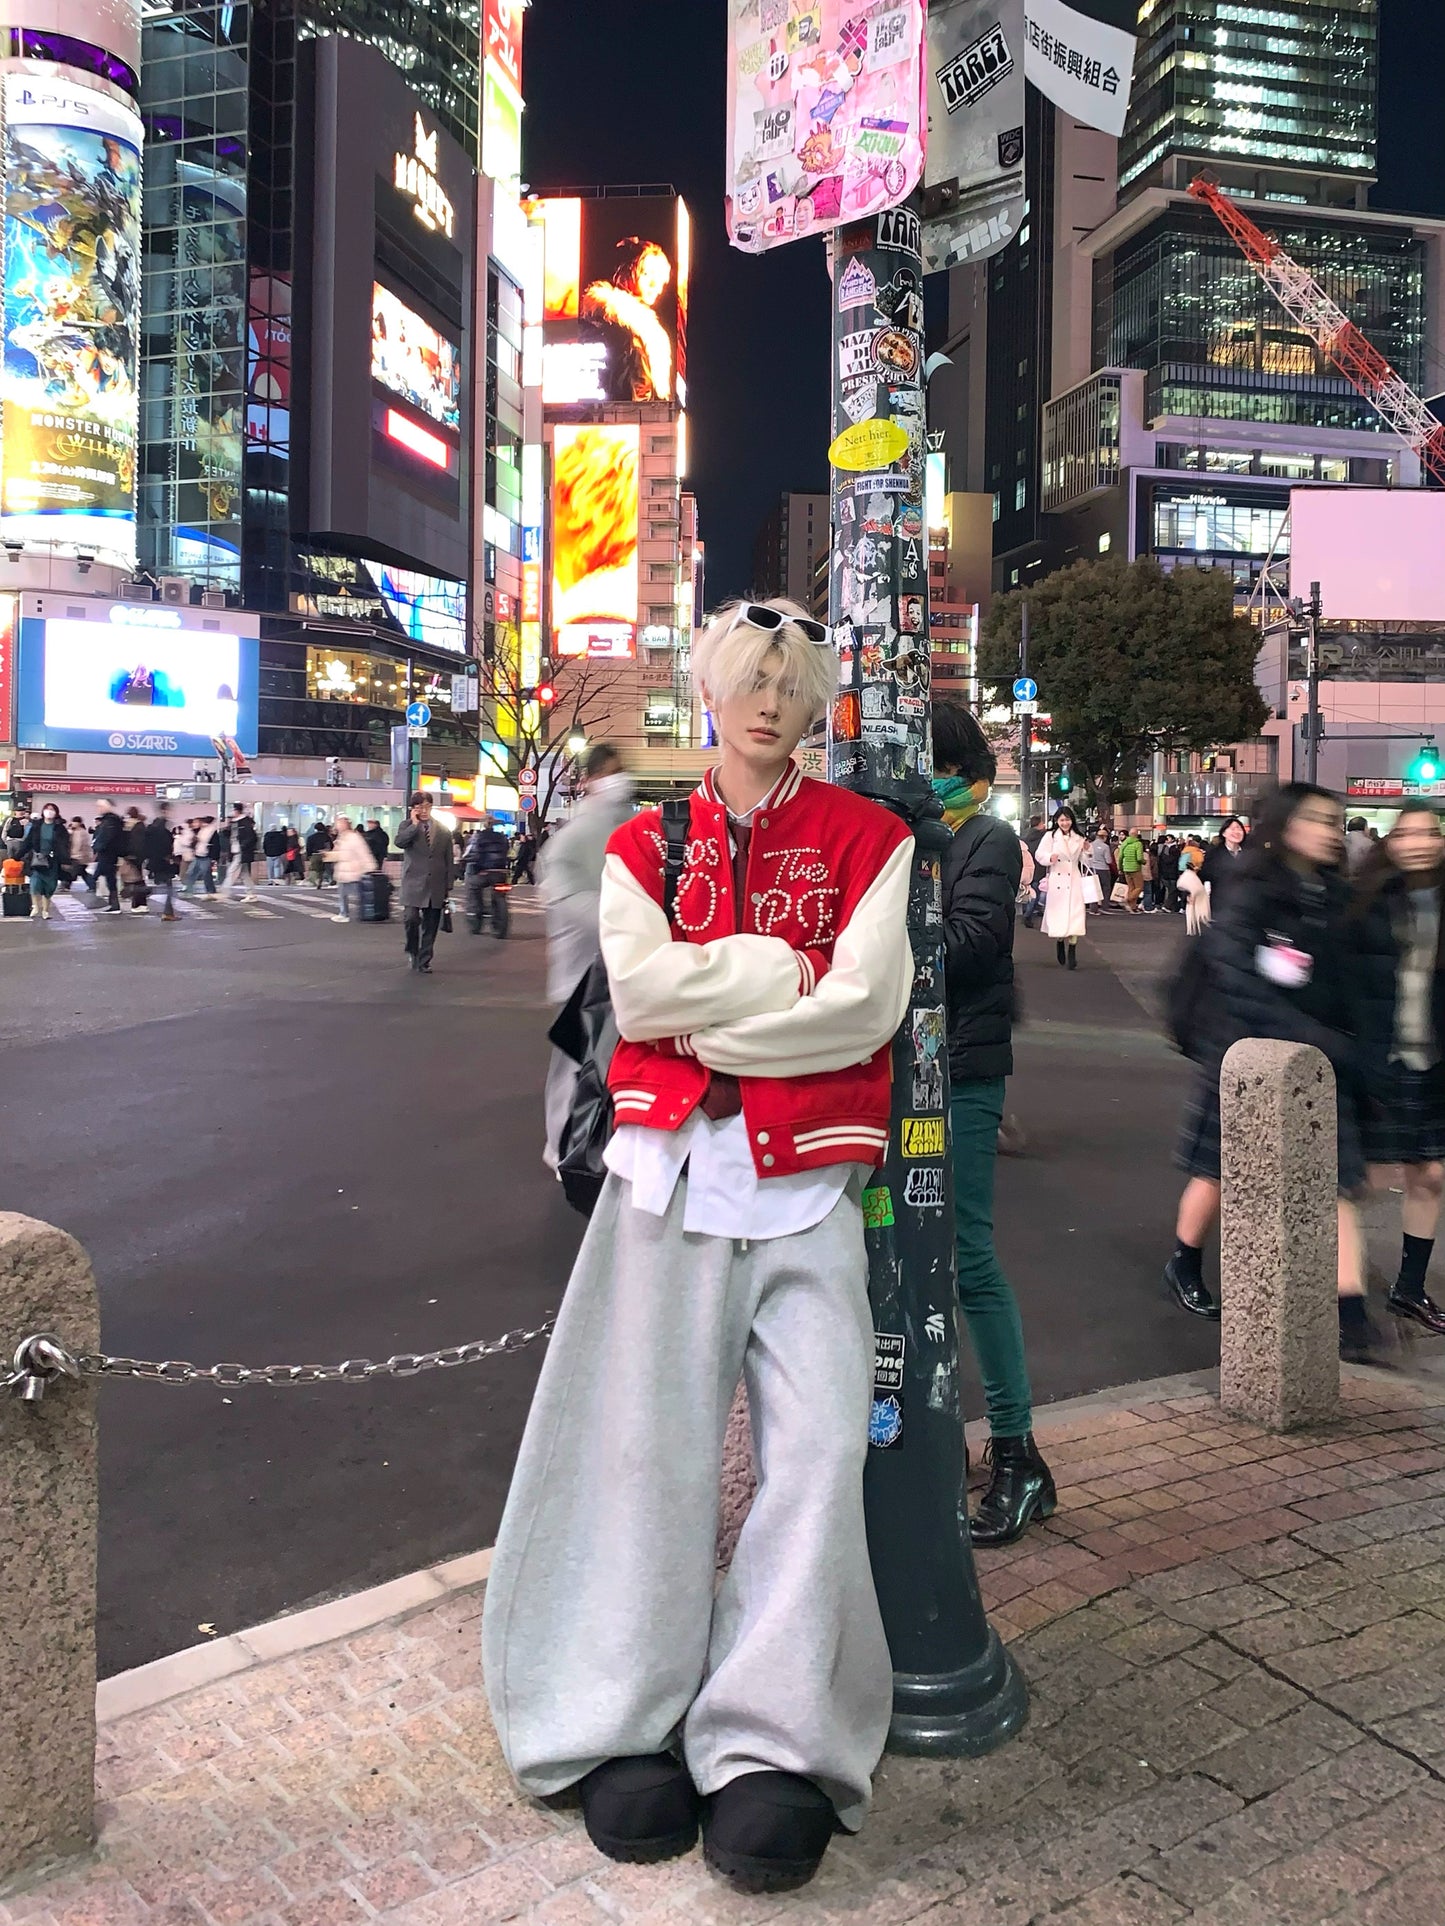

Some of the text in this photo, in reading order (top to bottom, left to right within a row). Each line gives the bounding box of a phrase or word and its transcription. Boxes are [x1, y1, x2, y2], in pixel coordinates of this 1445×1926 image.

[42, 94, 89, 115] PS5
[881, 211, 921, 255] TAR
[30, 413, 101, 436] MONSTER
[844, 435, 867, 447] Nett
[856, 480, 872, 492] FIGHT
[27, 783, 71, 792] SANZENRI
[875, 1371, 899, 1383] 回家
